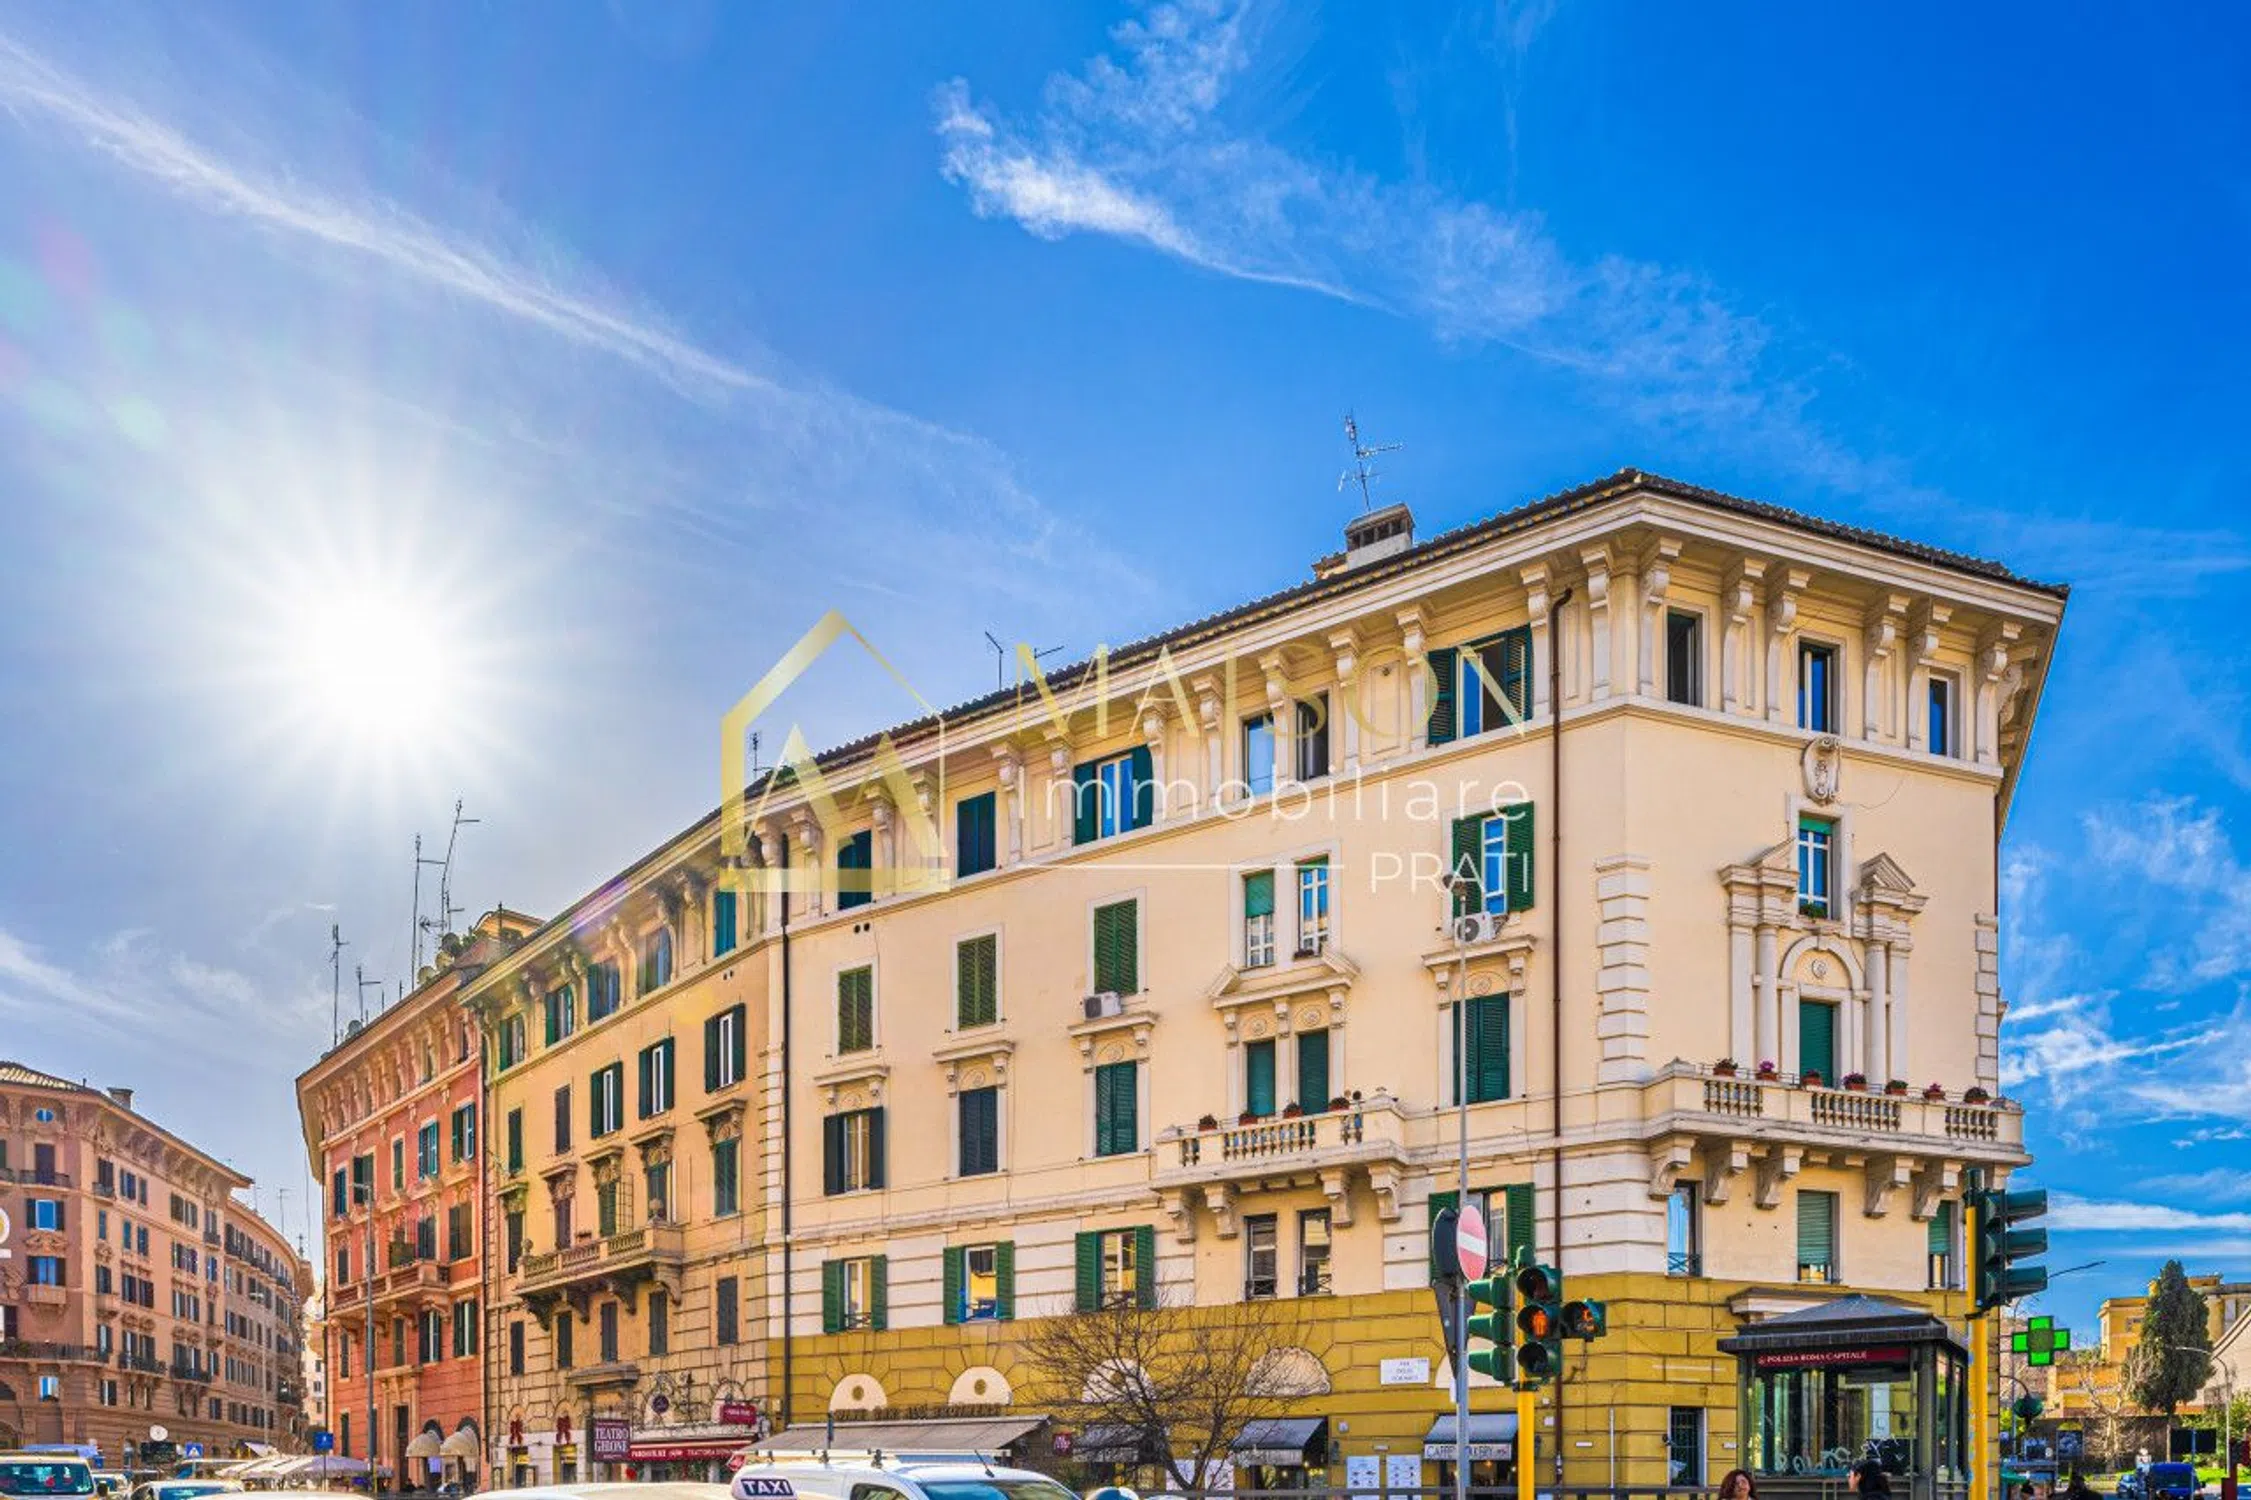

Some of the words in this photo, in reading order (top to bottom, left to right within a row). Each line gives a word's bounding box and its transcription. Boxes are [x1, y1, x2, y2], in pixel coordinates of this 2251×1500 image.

[1826, 1351, 1867, 1360] CAPITALE
[595, 1427, 629, 1440] TEATRO
[742, 1480, 791, 1494] TAXI
